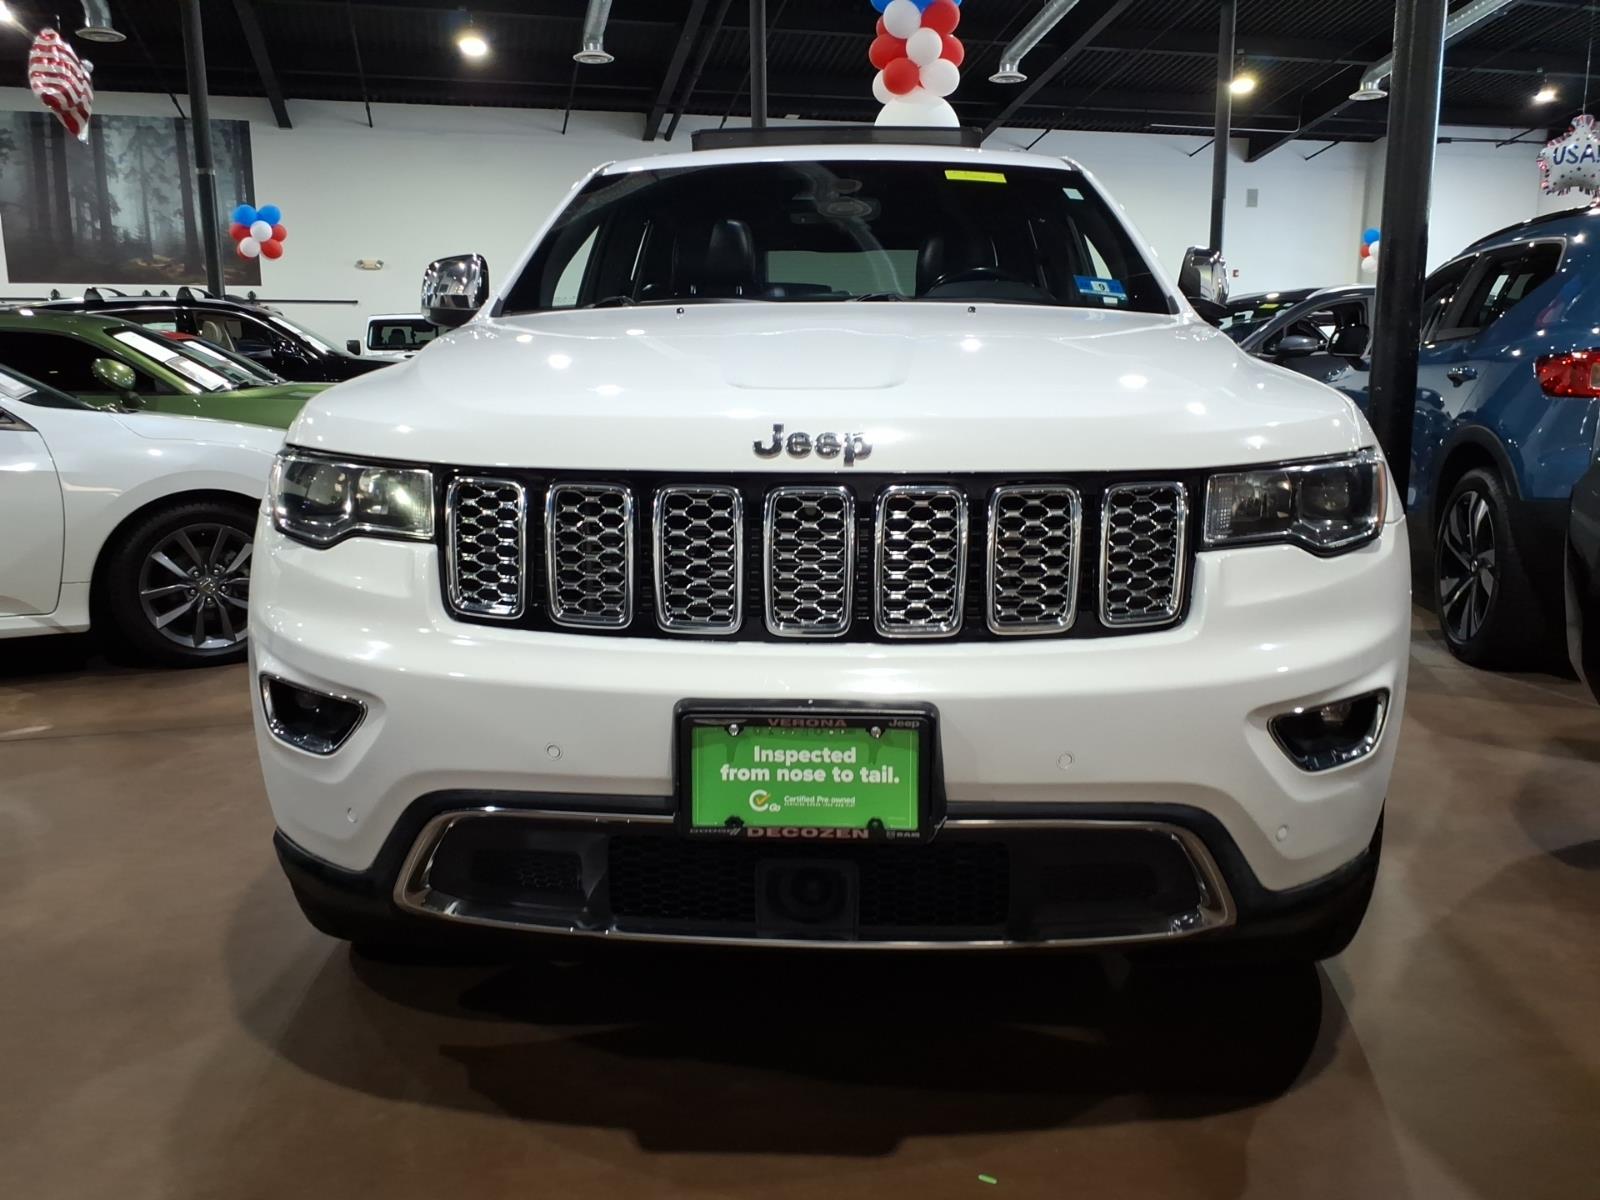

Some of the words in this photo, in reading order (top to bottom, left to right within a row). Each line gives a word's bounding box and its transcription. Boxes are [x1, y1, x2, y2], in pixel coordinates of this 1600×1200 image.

[753, 423, 873, 467] Jeep
[767, 718, 848, 728] VERONA
[888, 719, 920, 729] Jeep
[753, 745, 857, 766] Inspected
[720, 764, 771, 782] from
[776, 767, 827, 783] nose
[832, 766, 854, 783] to
[859, 766, 901, 785] tail.
[746, 827, 869, 840] DECOZEN
